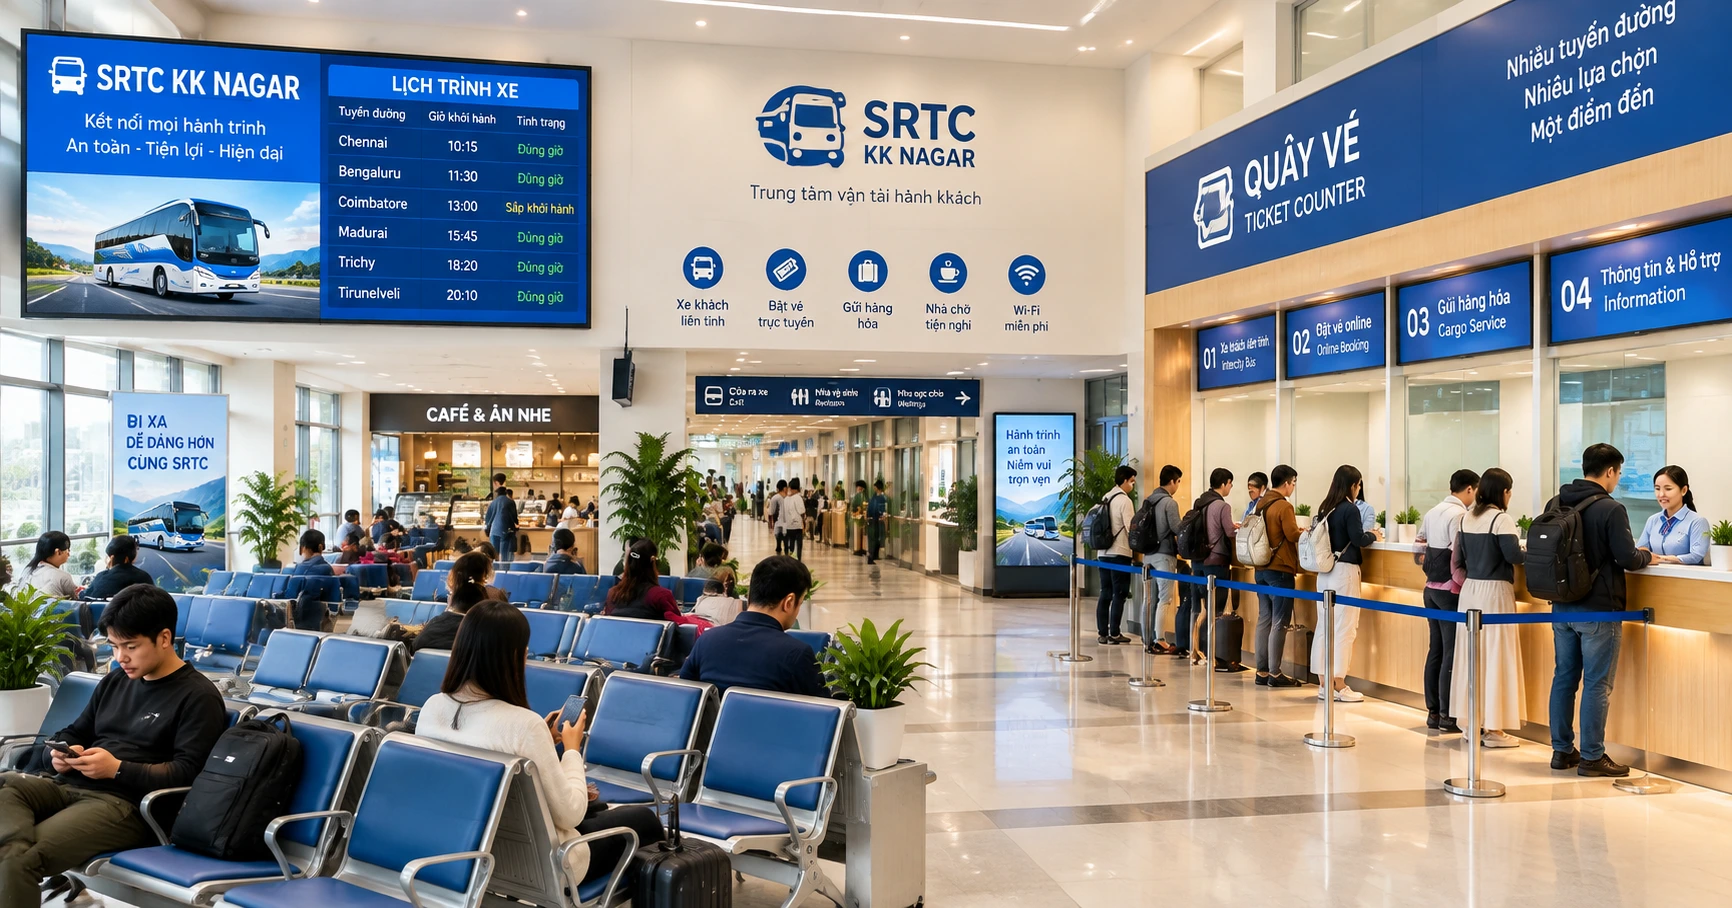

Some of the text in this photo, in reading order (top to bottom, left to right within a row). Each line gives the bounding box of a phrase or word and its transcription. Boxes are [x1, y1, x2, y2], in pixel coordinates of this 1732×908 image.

[1558, 20, 1608, 59] tuyến
[1614, 0, 1676, 38] đường
[96, 64, 300, 100] SRTC KK NAGAR
[392, 75, 519, 98] LỊCH TRÌNH XE
[1578, 65, 1605, 92] lựa
[863, 100, 976, 142] SRTC
[1531, 114, 1562, 144] Một
[1618, 83, 1654, 114] đến
[84, 112, 112, 129] Kết
[148, 116, 178, 135] mọi
[66, 138, 88, 152] An
[145, 141, 179, 158] Tiện
[219, 144, 256, 162] Hiện
[339, 135, 388, 149] Chennai
[448, 140, 478, 152] 10:15
[864, 145, 976, 168] KK NAGAR
[1244, 109, 1360, 200] QUÂY VÉ
[339, 165, 401, 181] Bengaluru
[448, 170, 478, 182] 11:30
[338, 196, 408, 210] Coimbatore
[750, 184, 796, 203] Trung
[838, 187, 864, 206] vận
[448, 201, 478, 212] 13:00
[1244, 176, 1366, 233] TICKET COUNTER
[338, 226, 388, 239] Madurai
[448, 231, 478, 242] 15:45
[338, 256, 375, 270] Trichy
[448, 260, 478, 271] 18:20
[1561, 276, 1592, 312] 04
[1665, 256, 1675, 275] &
[1700, 251, 1721, 272] trợ
[338, 286, 400, 300] Tirunelveli
[447, 289, 478, 301] 20:10
[1604, 285, 1686, 312] Information
[677, 299, 691, 310] Xe
[1013, 305, 1040, 315] Wi-Fi
[1407, 306, 1430, 338] 03
[1489, 289, 1510, 307] hóa
[949, 319, 971, 332] nghi
[1438, 315, 1506, 338] Cargo Service
[1293, 329, 1310, 355] 02
[1333, 319, 1343, 333] vé
[1345, 315, 1372, 332] online
[1204, 347, 1216, 369] 01
[426, 403, 469, 422] CAFÉ
[473, 408, 486, 422] &
[518, 408, 551, 422] NHE
[148, 415, 167, 428] XA
[1008, 446, 1020, 454] an
[173, 456, 208, 470] SRTC
[1036, 459, 1051, 470] vui
[1008, 476, 1050, 486] trọn vẹn
